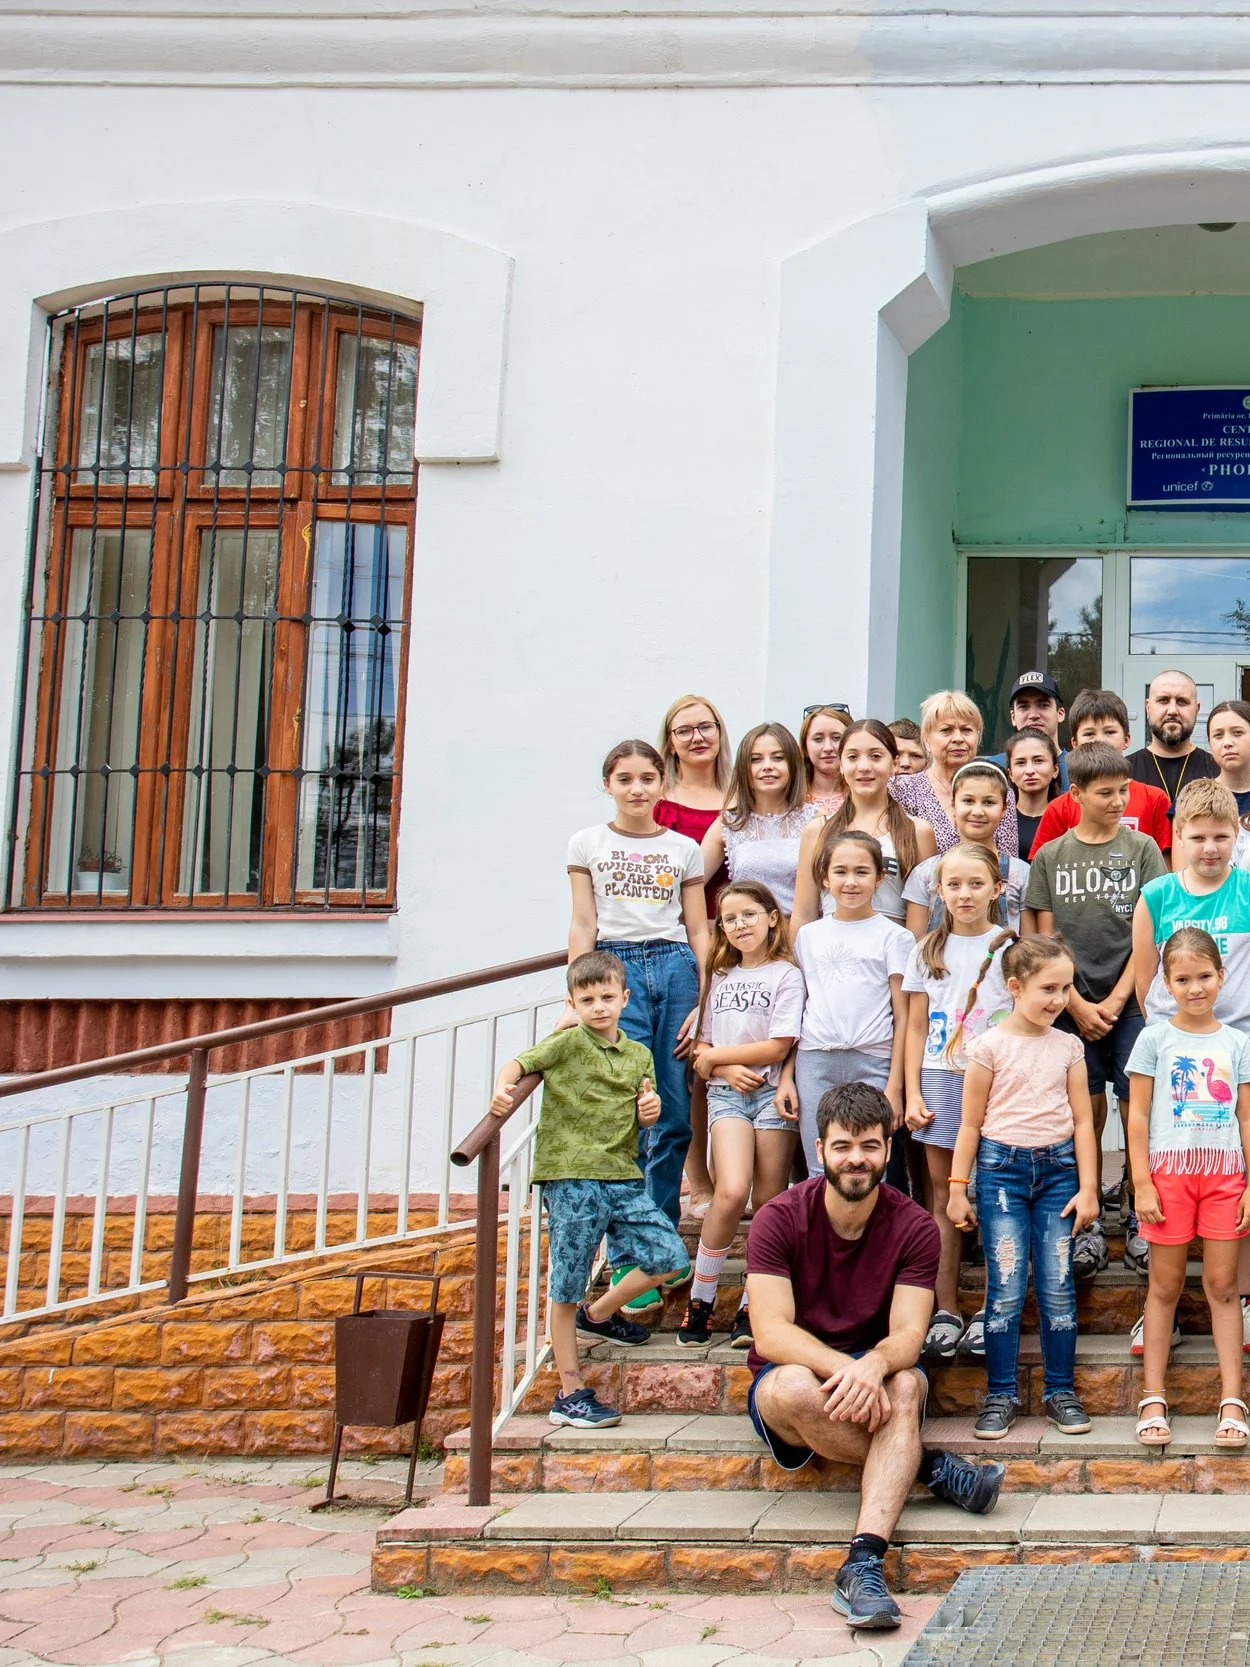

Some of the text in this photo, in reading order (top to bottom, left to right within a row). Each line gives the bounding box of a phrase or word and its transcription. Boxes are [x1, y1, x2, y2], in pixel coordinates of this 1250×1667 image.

[1140, 438, 1199, 449] REGIONAL
[1201, 438, 1216, 447] DE
[1151, 452, 1214, 460] Региональный
[1162, 481, 1199, 492] unicef
[597, 862, 680, 878] WHERE YOU
[1056, 860, 1136, 869] AERONAUTIC
[627, 873, 654, 885] ARE
[605, 882, 674, 904] PLANTED!
[1064, 895, 1086, 903] NEW
[719, 981, 767, 992] FANTASTIC
[713, 990, 771, 1013] BEASTS
